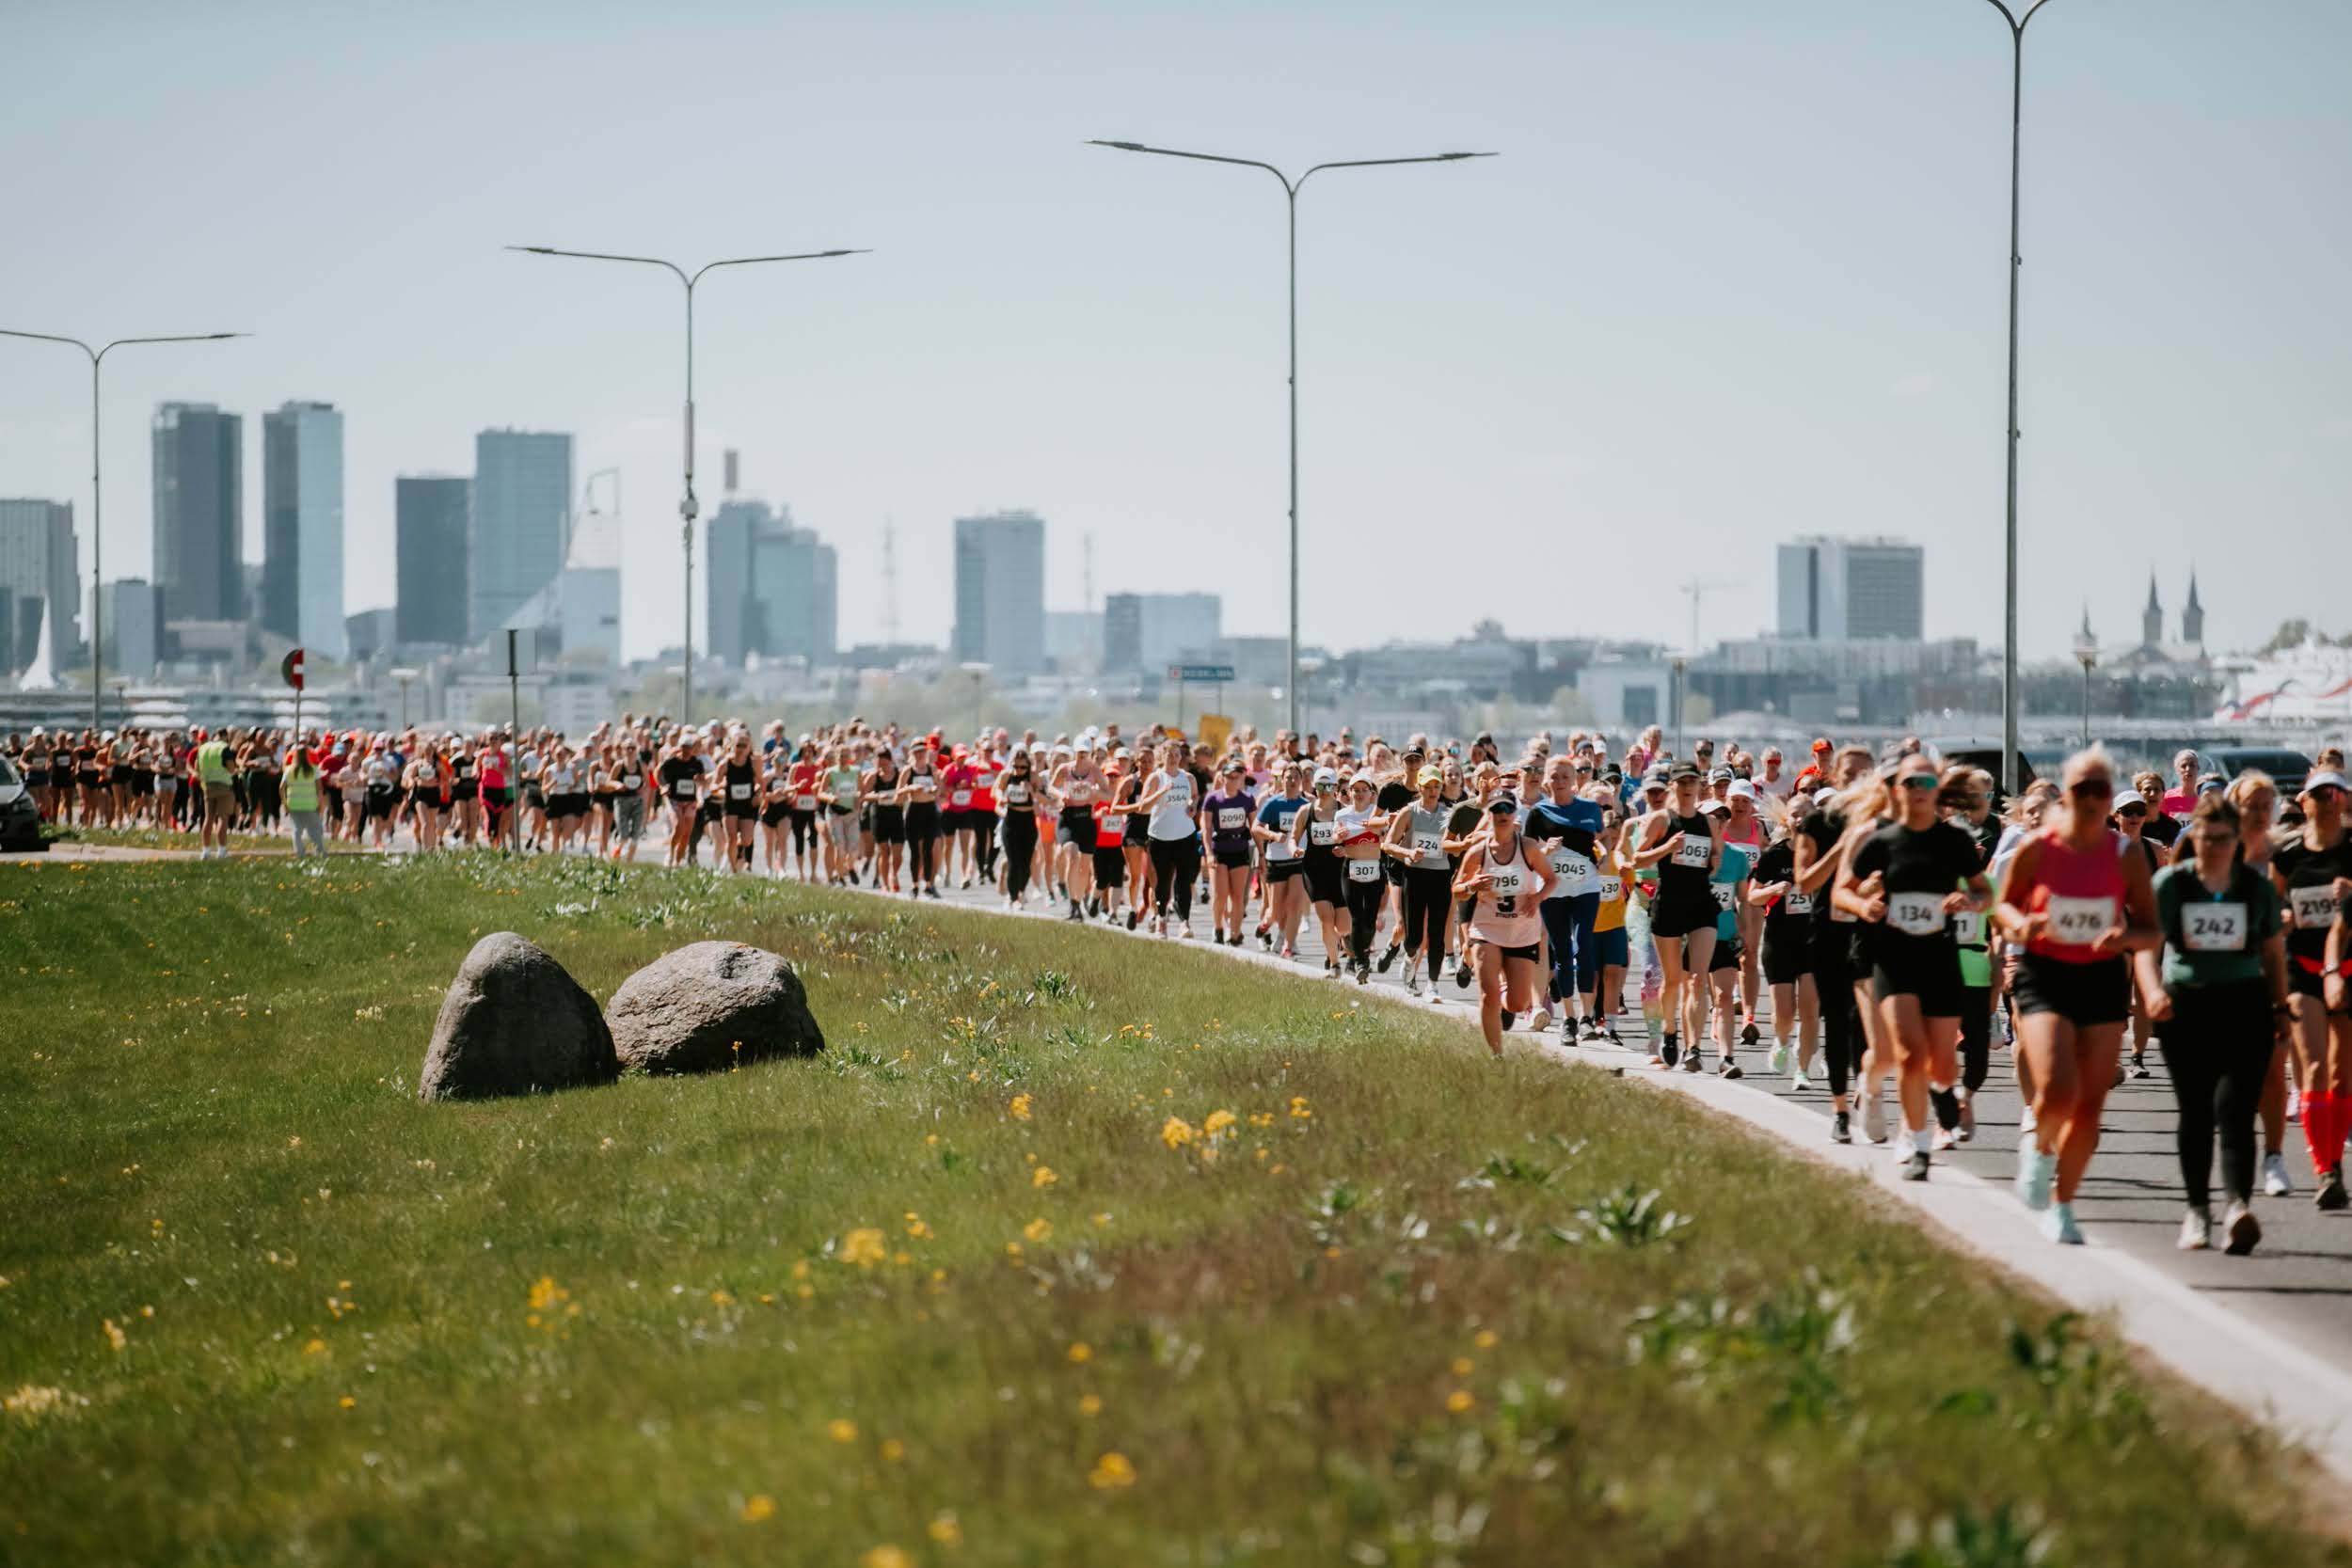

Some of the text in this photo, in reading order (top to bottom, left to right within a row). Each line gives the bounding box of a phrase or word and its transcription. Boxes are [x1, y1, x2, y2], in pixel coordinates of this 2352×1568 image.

[1221, 814, 1244, 823] 2090
[1313, 829, 1331, 839] 293
[1418, 839, 1438, 851] 224
[1356, 866, 1375, 877] 307
[1554, 863, 1587, 876] 3045
[1495, 874, 1519, 888] 796
[1899, 904, 1932, 922] 134
[2059, 911, 2102, 930] 476
[2193, 917, 2235, 935] 242
